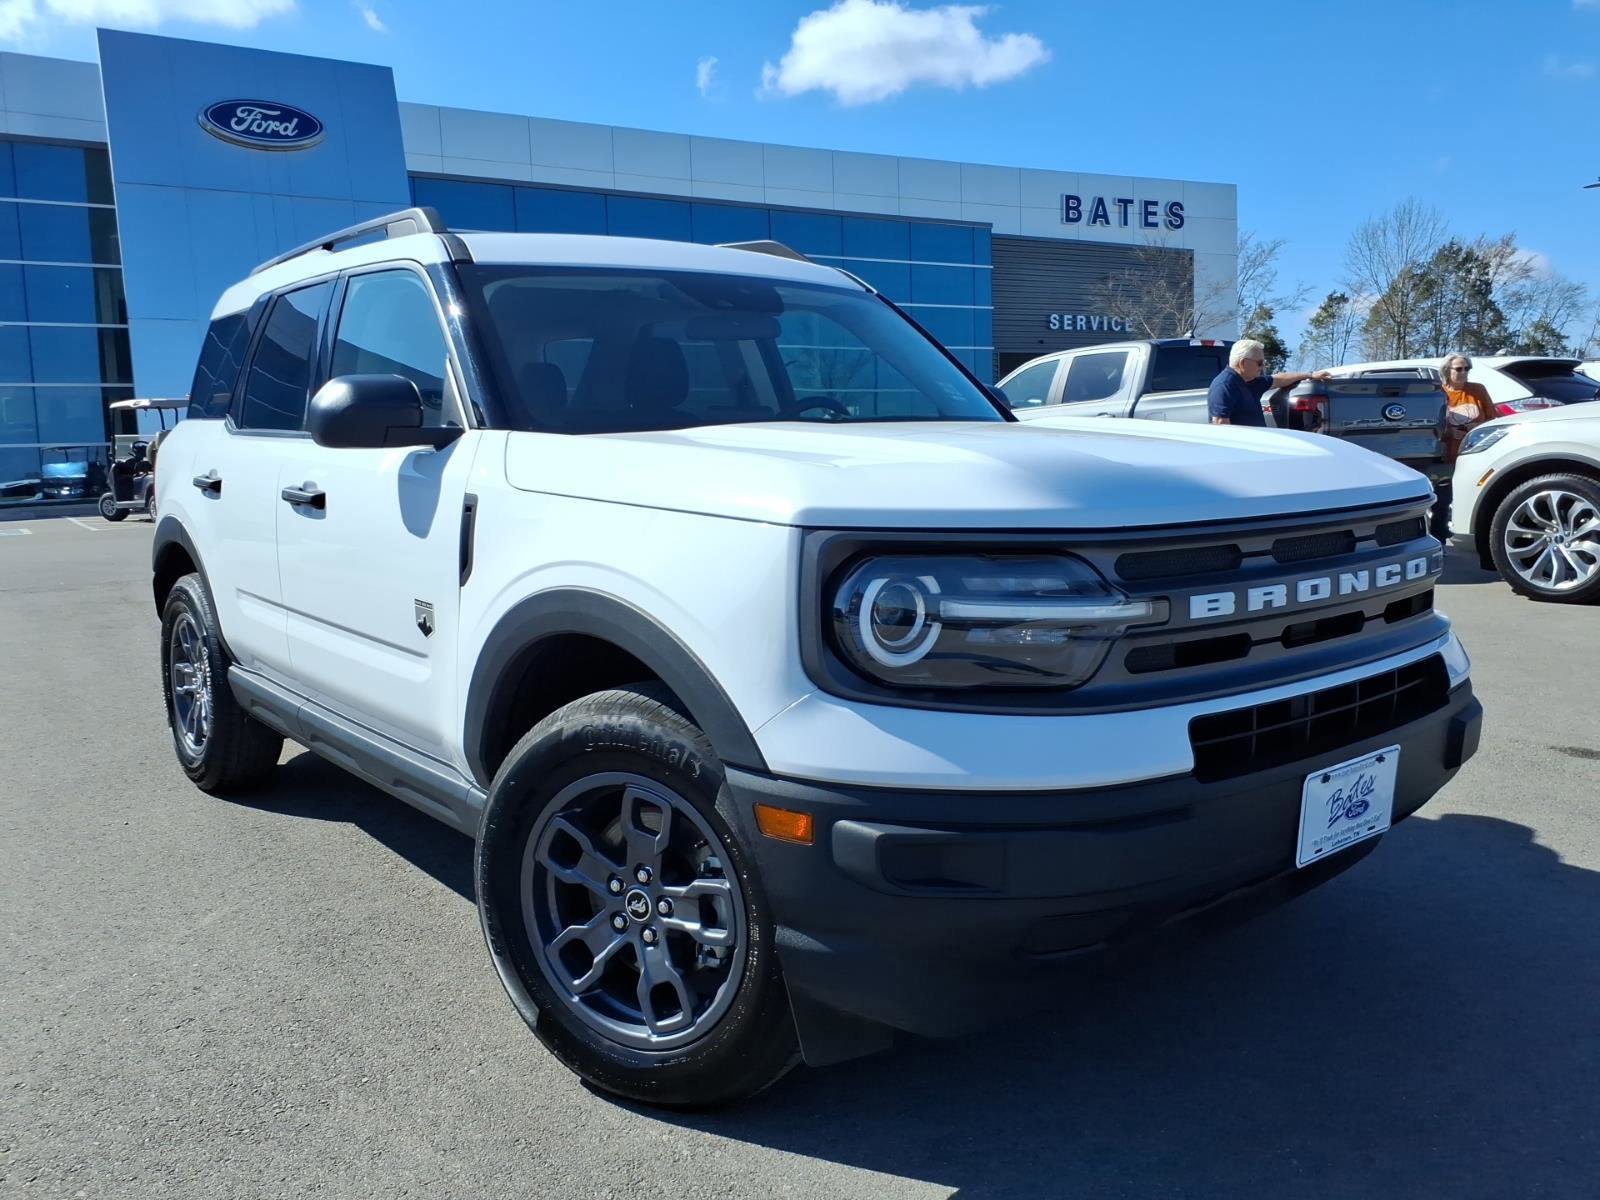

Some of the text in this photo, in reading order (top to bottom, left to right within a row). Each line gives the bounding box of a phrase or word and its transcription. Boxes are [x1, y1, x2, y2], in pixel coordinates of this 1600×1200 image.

[230, 106, 299, 136] Ford
[1062, 194, 1185, 230] BATES
[1049, 313, 1134, 332] SERVICE
[1189, 557, 1427, 619] BRONCO
[1326, 772, 1377, 826] Bates
